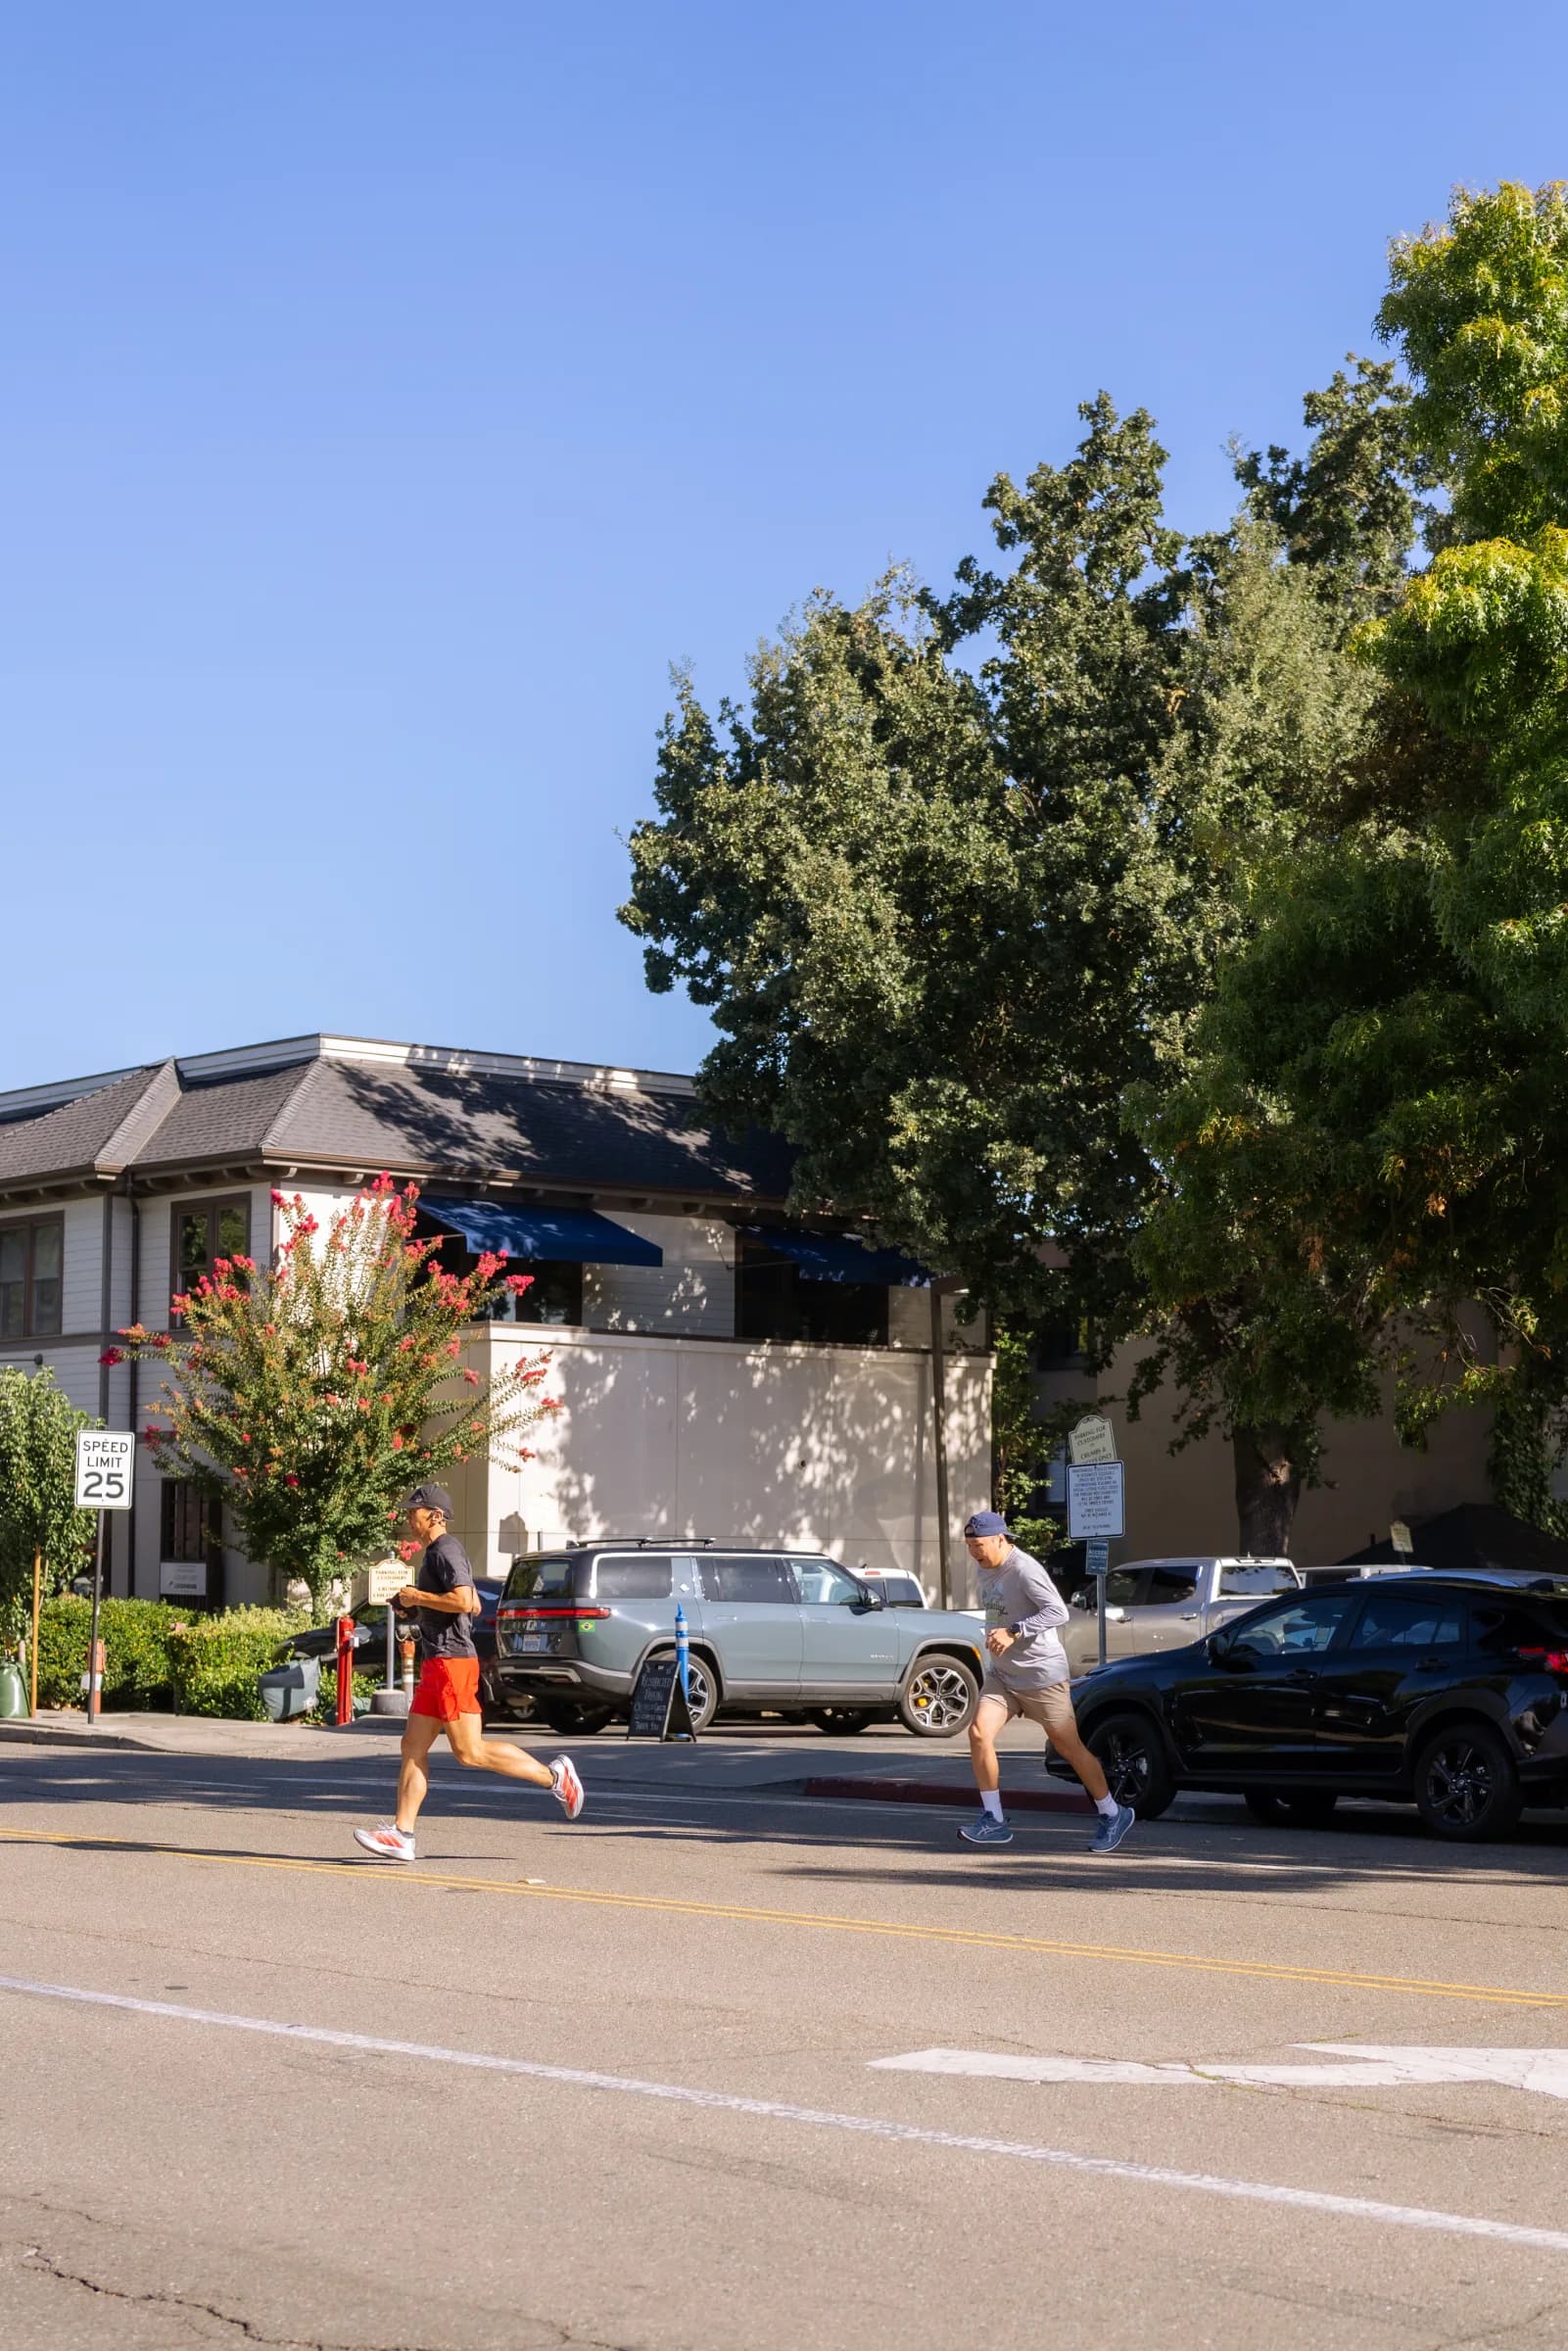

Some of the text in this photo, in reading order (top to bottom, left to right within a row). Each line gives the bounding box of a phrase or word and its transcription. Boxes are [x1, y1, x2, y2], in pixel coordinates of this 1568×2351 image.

[83, 1441, 128, 1453] SPEED
[87, 1456, 122, 1468] LIMIT
[83, 1471, 124, 1499] 25
